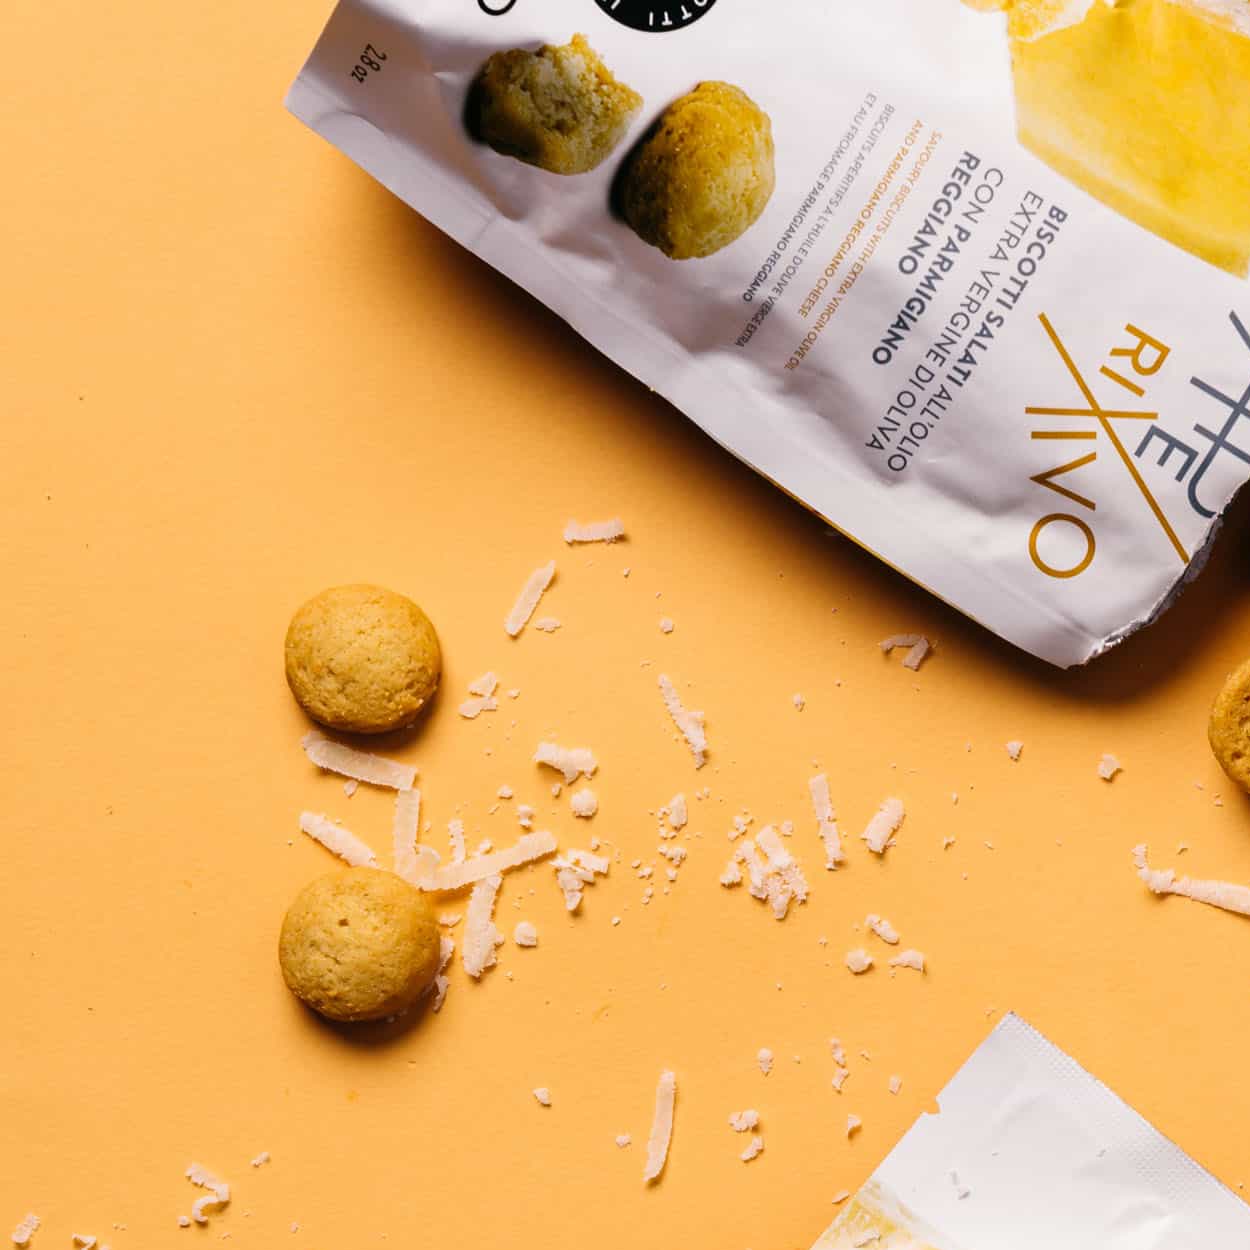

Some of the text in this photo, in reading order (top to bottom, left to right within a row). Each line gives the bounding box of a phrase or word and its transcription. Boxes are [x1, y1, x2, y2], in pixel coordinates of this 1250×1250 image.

[351, 44, 387, 83] 2.8 oz
[860, 104, 896, 155] BISCUITS
[904, 129, 944, 187] SAVOURY
[739, 92, 878, 305] ET AU FROMAGE PARMIGIANO REGGIANO
[797, 118, 924, 320] AND PARMIGIANO REGGIANO CHEESE
[875, 184, 912, 236] BISCUITS
[898, 150, 981, 275] REGGIANO
[858, 232, 883, 264] WITH
[872, 168, 1003, 365] CON PARMIGIANO
[995, 205, 1068, 311] BISCOTTI
[835, 261, 864, 298] EXTRA
[733, 321, 758, 347] EXTRA
[747, 295, 778, 327] VIERGE
[809, 293, 843, 334] VIRGIN
[865, 190, 1044, 451] EXTRA VERGINE DI OLIVA
[793, 331, 818, 360] OLIVE
[945, 310, 1004, 388] SALATI
